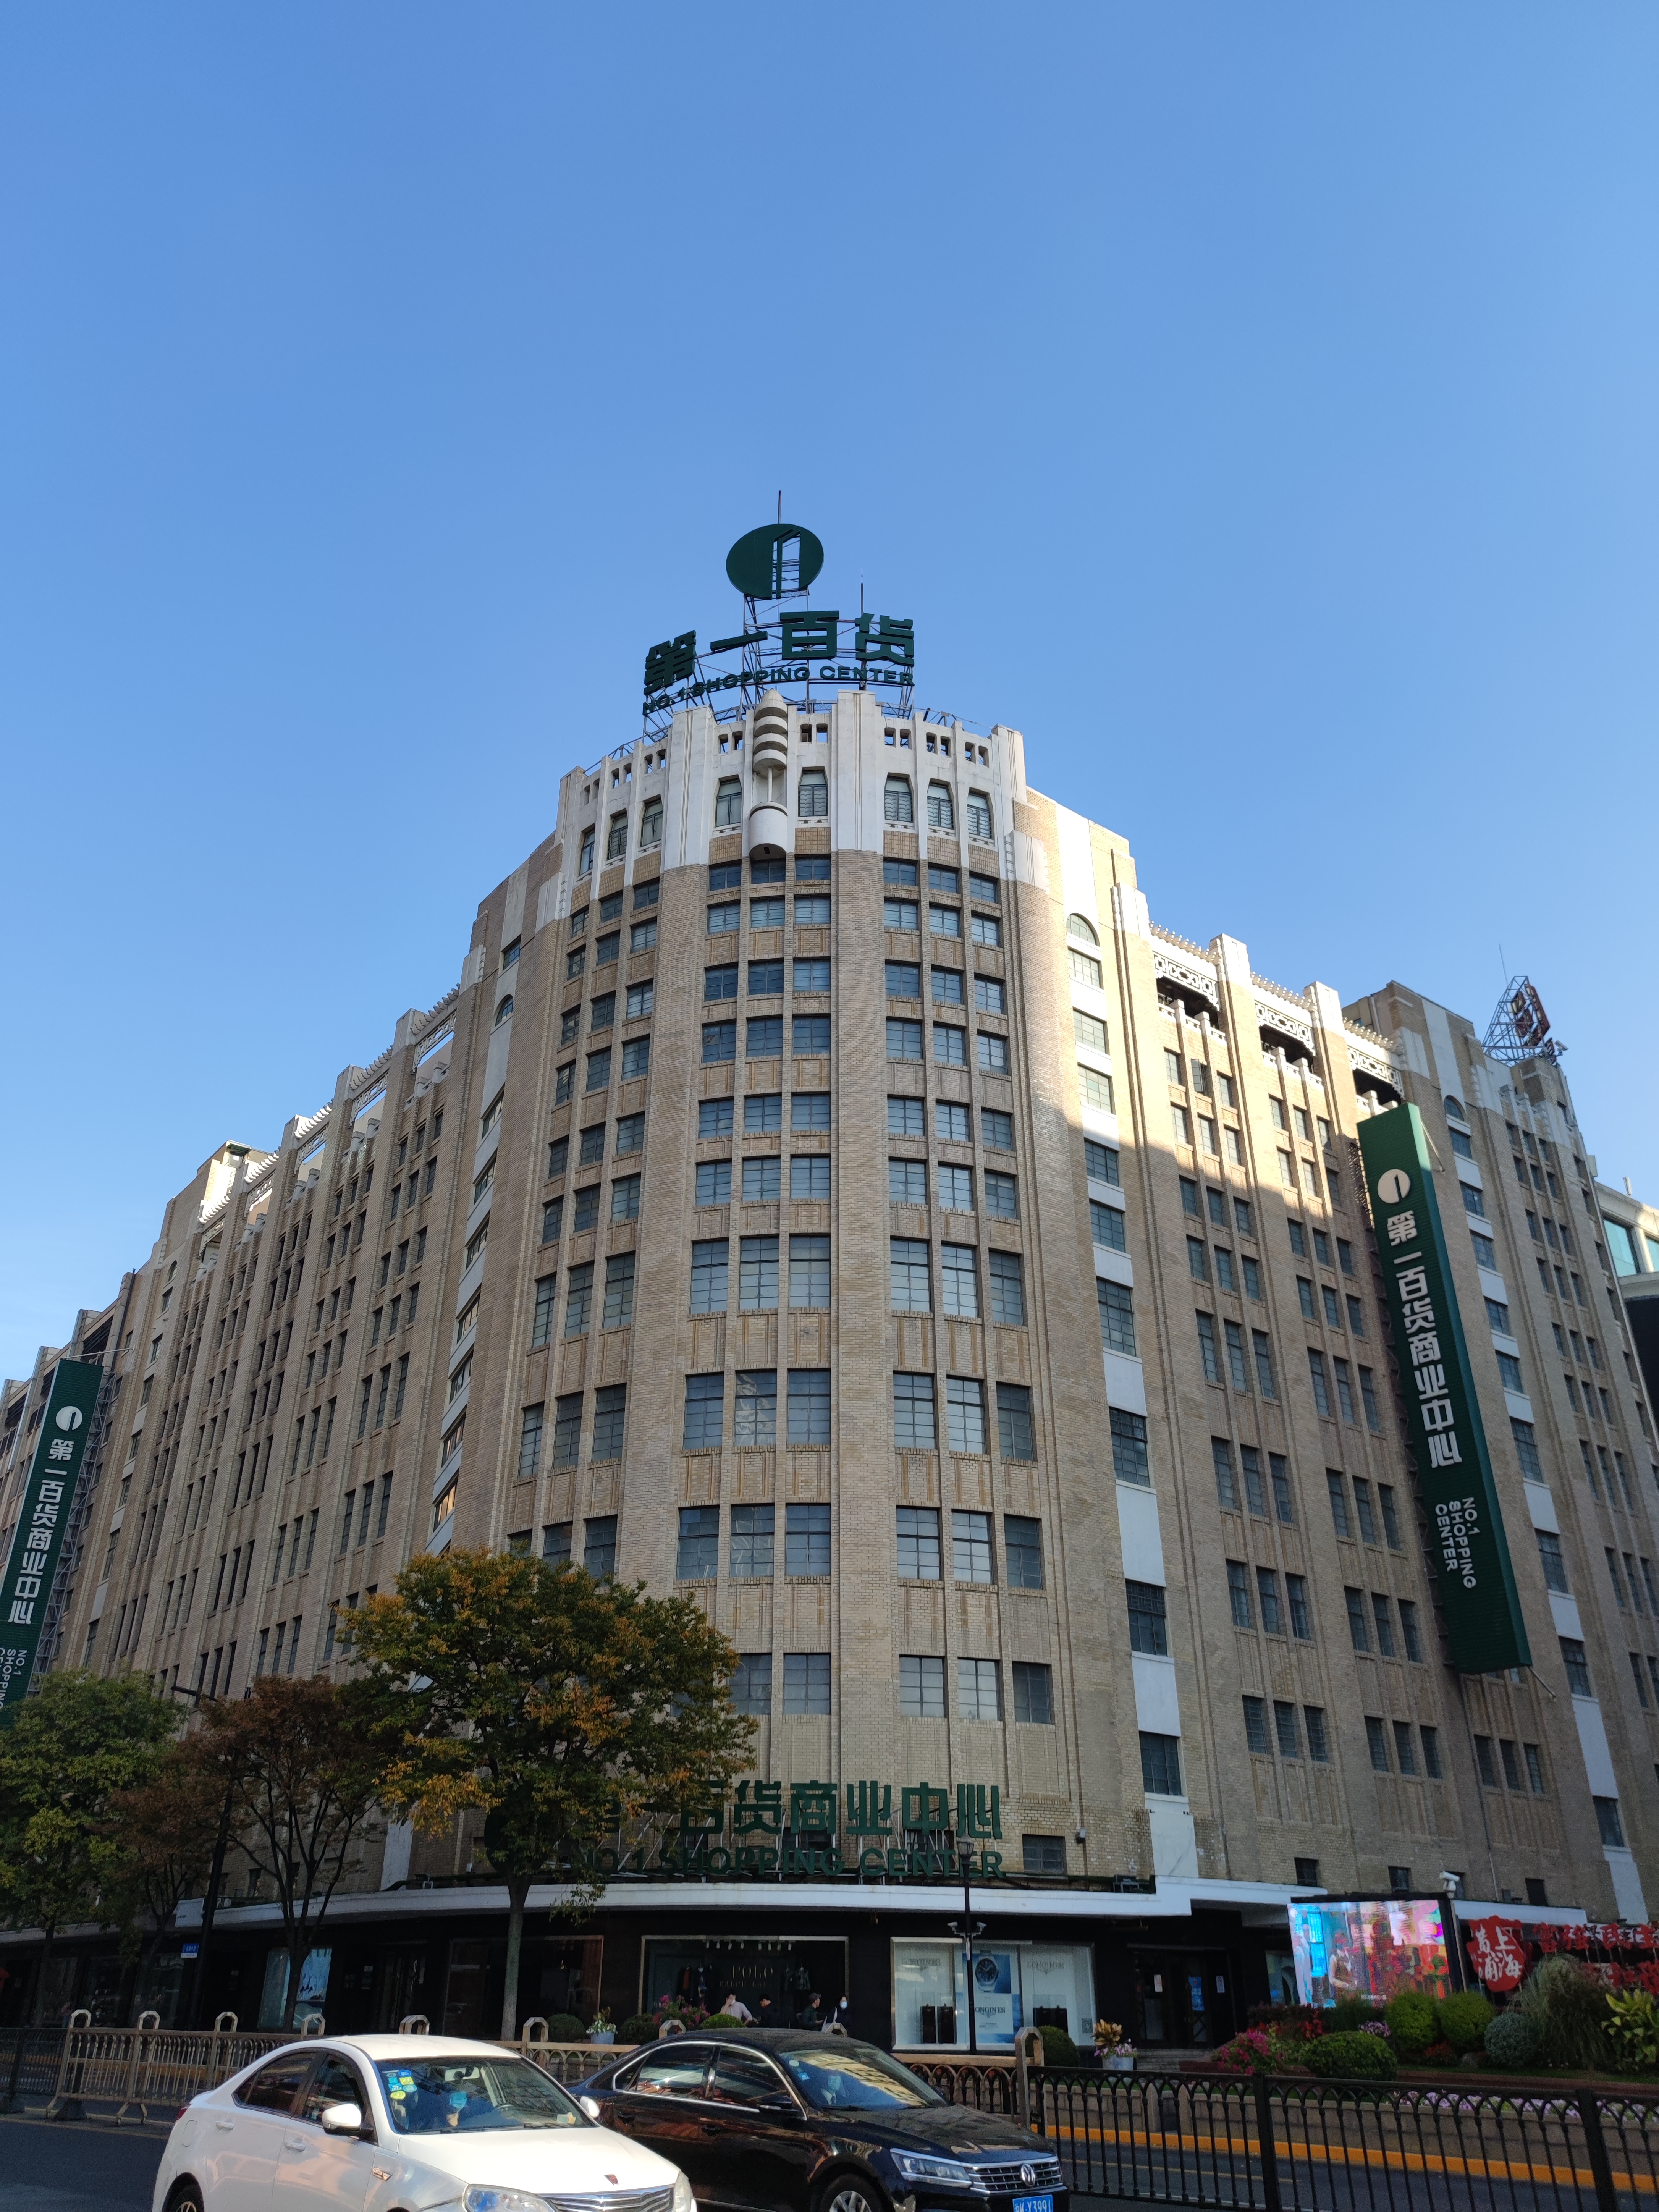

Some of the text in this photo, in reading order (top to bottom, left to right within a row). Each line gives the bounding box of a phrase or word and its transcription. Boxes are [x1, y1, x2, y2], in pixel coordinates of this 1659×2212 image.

[643, 611, 915, 695] 第一百货
[643, 666, 915, 716] NO.1 SHOPPING CENTER
[1387, 1210, 1462, 1468] 第一百货商业中心
[8, 1439, 74, 1624] 第一百货商业中心
[1435, 1503, 1458, 1572] CENTER
[1449, 1501, 1476, 1588] SHOPPING
[1462, 1497, 1480, 1535] NO.1
[13, 1649, 27, 1675] NO.1
[657, 1846, 845, 1876] SHOPPING
[860, 1848, 1004, 1878] CENTER
[732, 1965, 774, 1979] POLO
